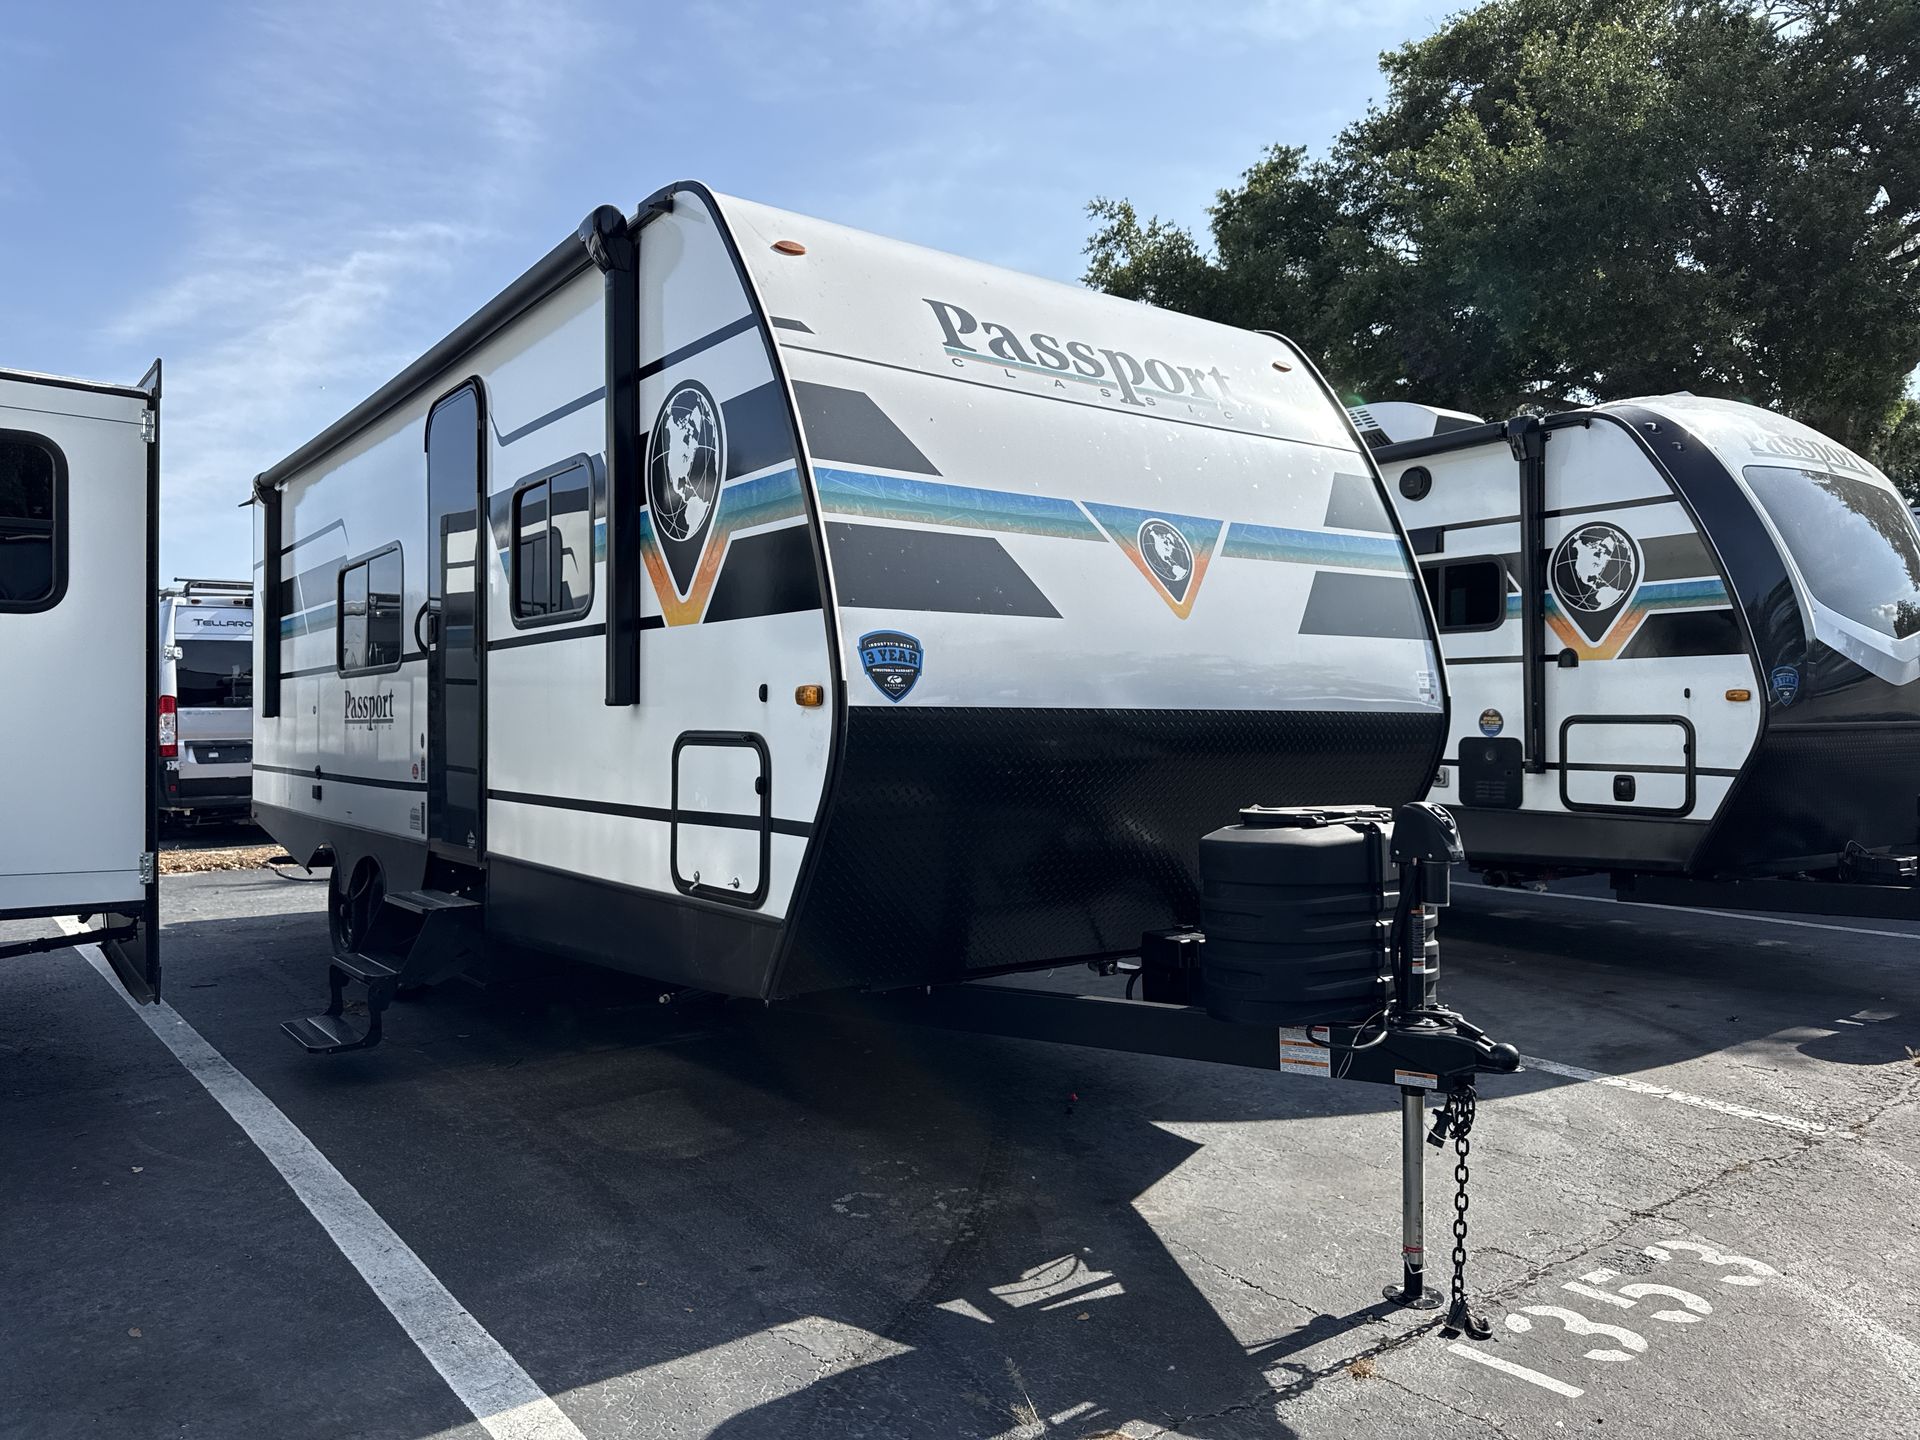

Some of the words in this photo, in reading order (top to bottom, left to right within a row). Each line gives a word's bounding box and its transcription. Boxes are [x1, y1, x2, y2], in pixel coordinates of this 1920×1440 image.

[922, 297, 1230, 407] Passport
[951, 357, 1235, 420] CLASSIC
[193, 618, 253, 628] TELLARO
[866, 651, 875, 664] 3
[878, 649, 917, 664] YEAR
[344, 688, 394, 731] Passport
[1446, 1240, 1779, 1399] 1353
